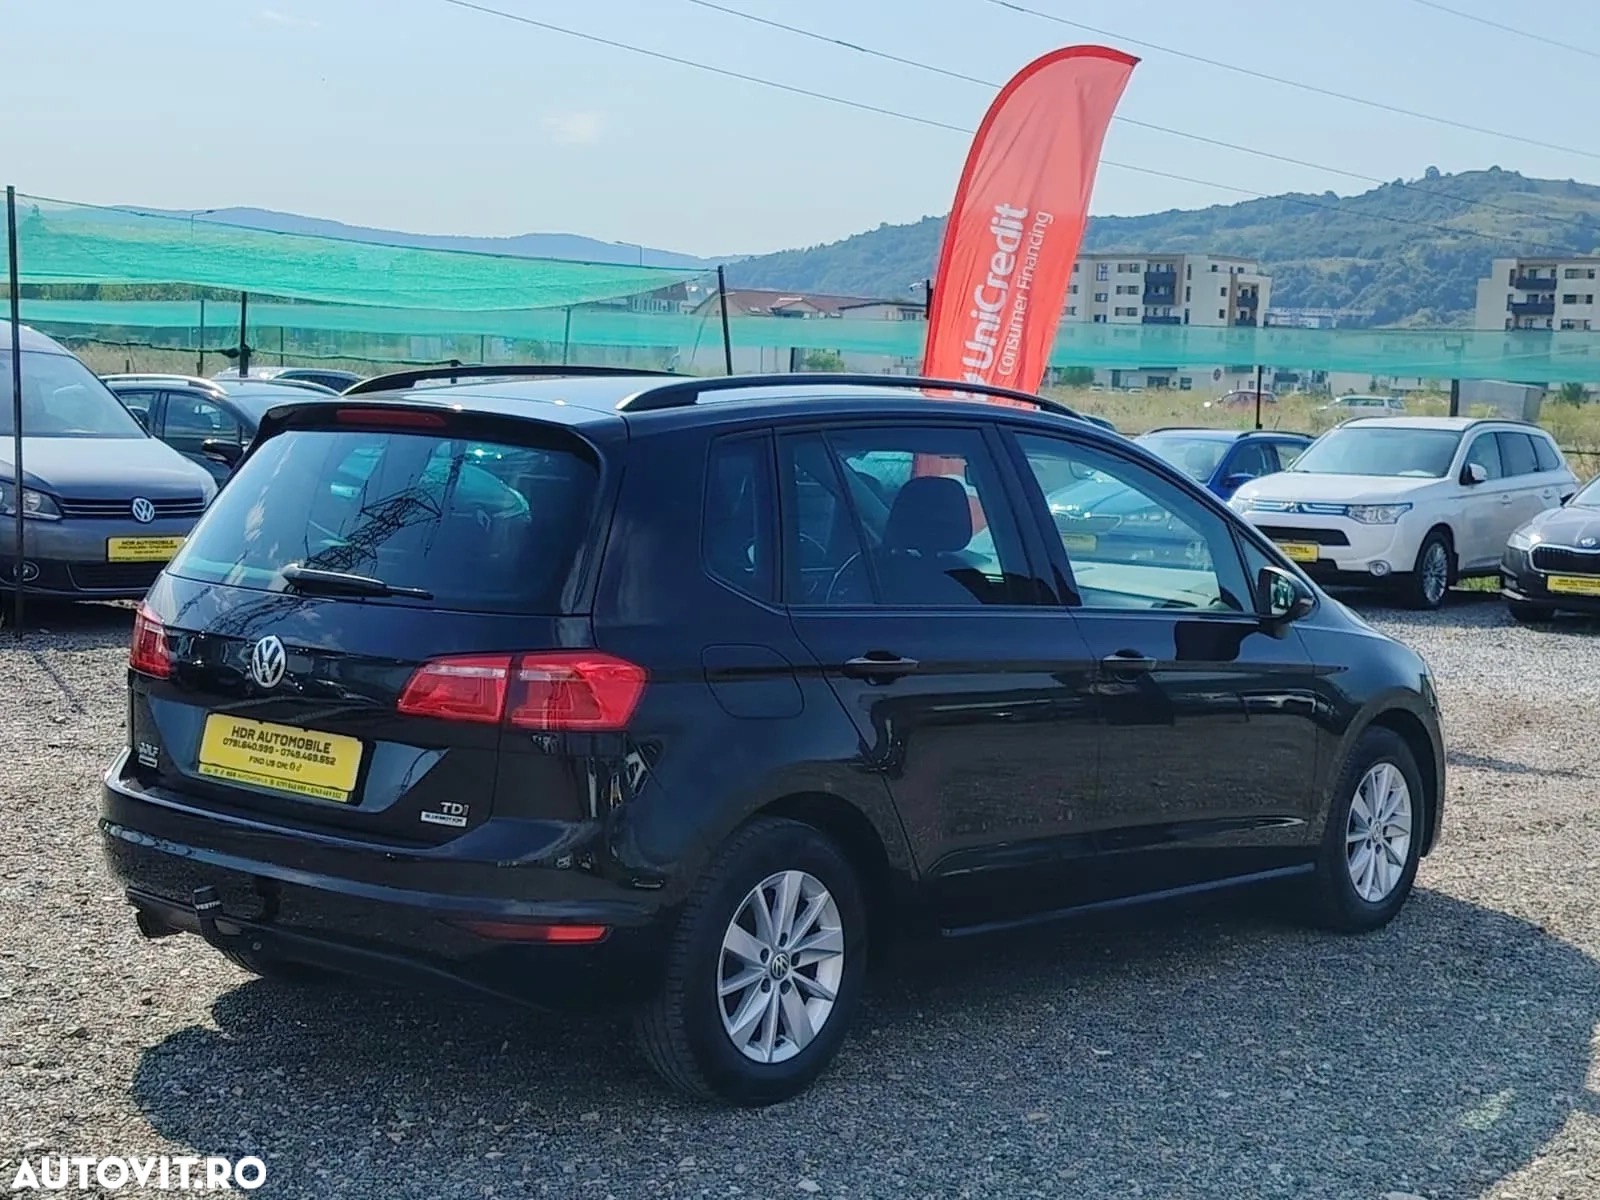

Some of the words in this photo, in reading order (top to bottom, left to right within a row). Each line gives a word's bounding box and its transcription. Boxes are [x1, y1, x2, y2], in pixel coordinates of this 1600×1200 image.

[961, 203, 1028, 370] UniCredit
[998, 292, 1029, 376] Consumer
[1016, 211, 1054, 289] Financing
[232, 726, 255, 739] HDR
[257, 731, 332, 754] AUTOMOBILE
